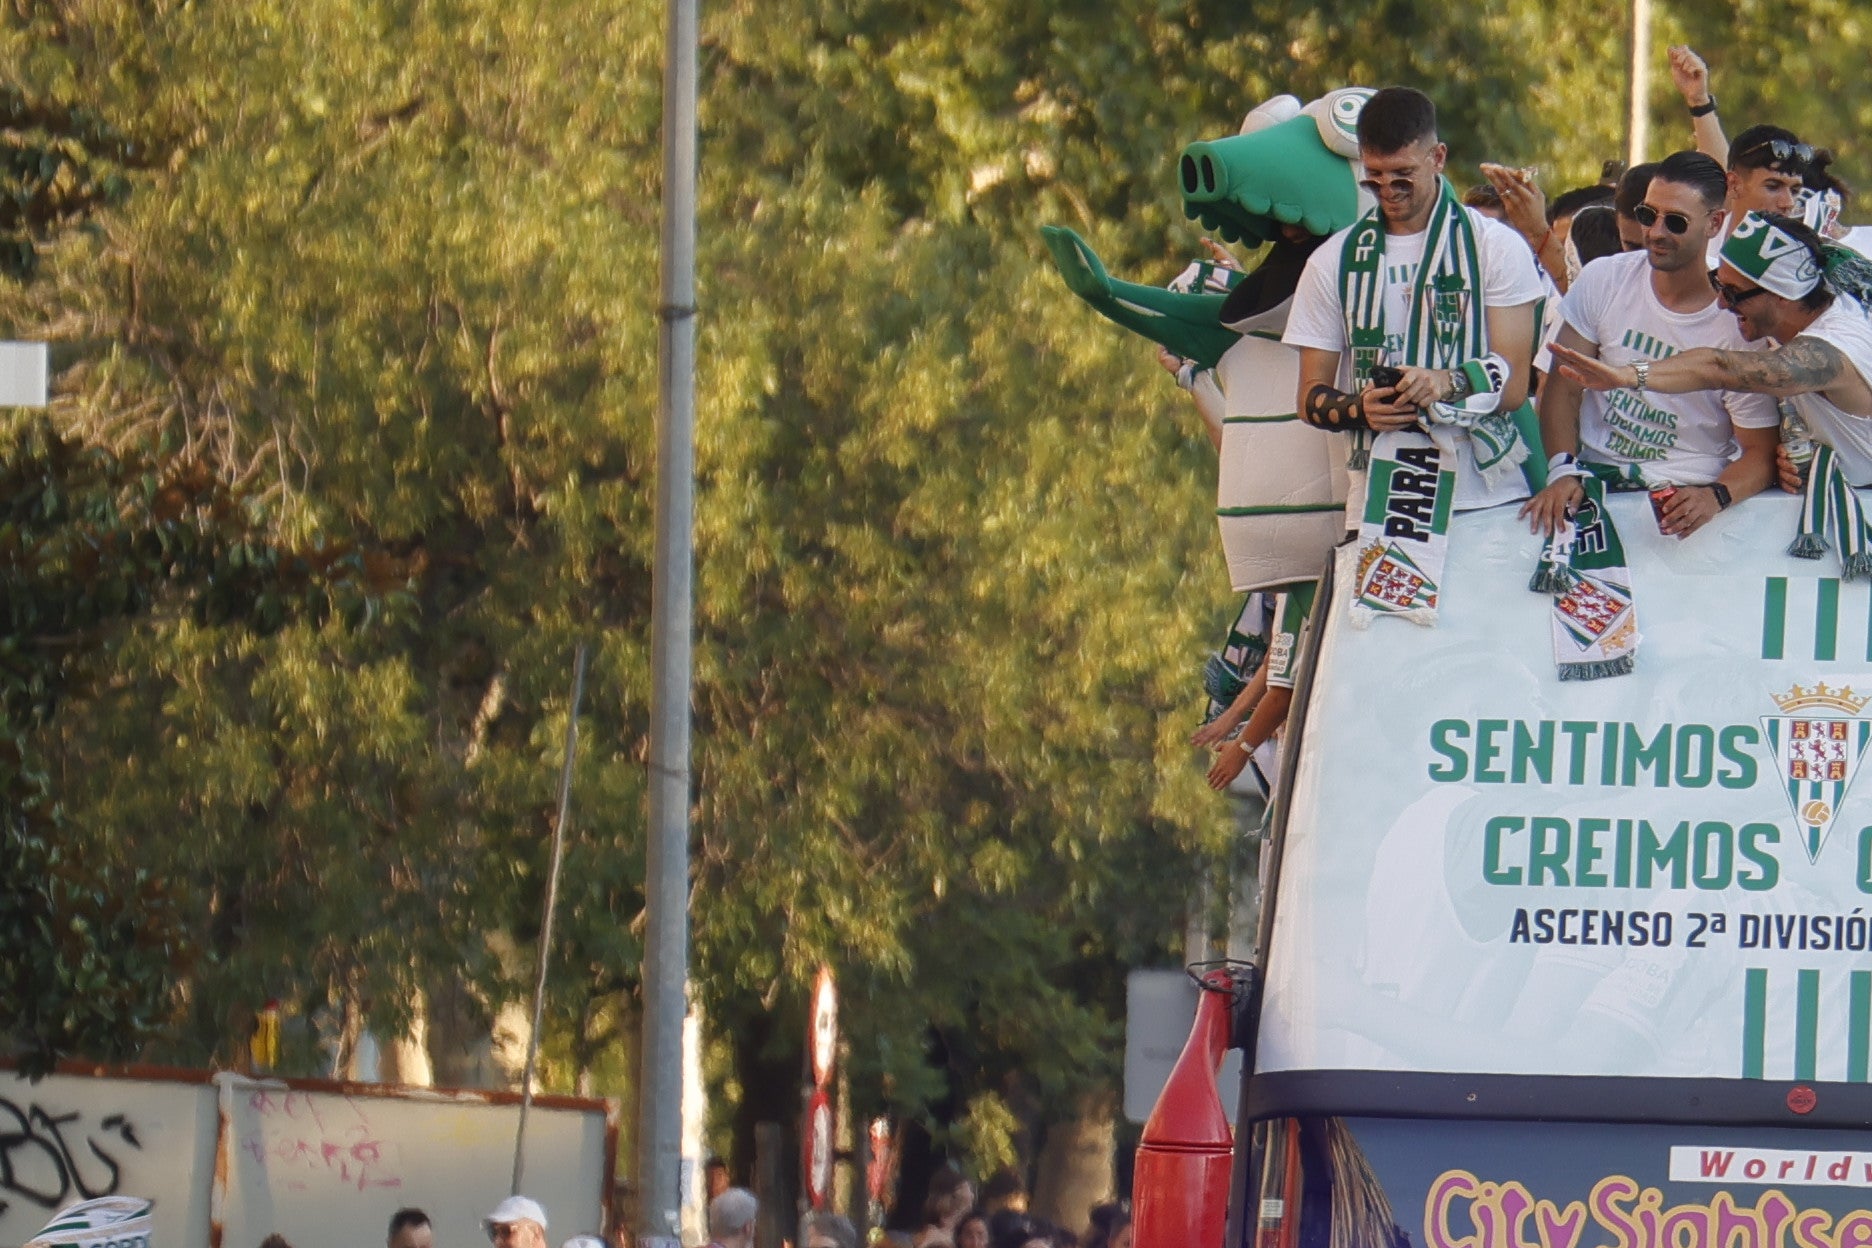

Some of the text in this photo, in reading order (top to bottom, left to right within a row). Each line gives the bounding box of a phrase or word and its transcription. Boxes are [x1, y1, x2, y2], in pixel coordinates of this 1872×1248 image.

[1605, 389, 1679, 430] SENTIMOS
[1384, 447, 1440, 543] PARA
[1428, 718, 1759, 789] SENTIMOS
[1482, 816, 1780, 891] CREIMOS
[1509, 908, 1673, 947] ASCENSO
[1686, 912, 1726, 948] 2ª
